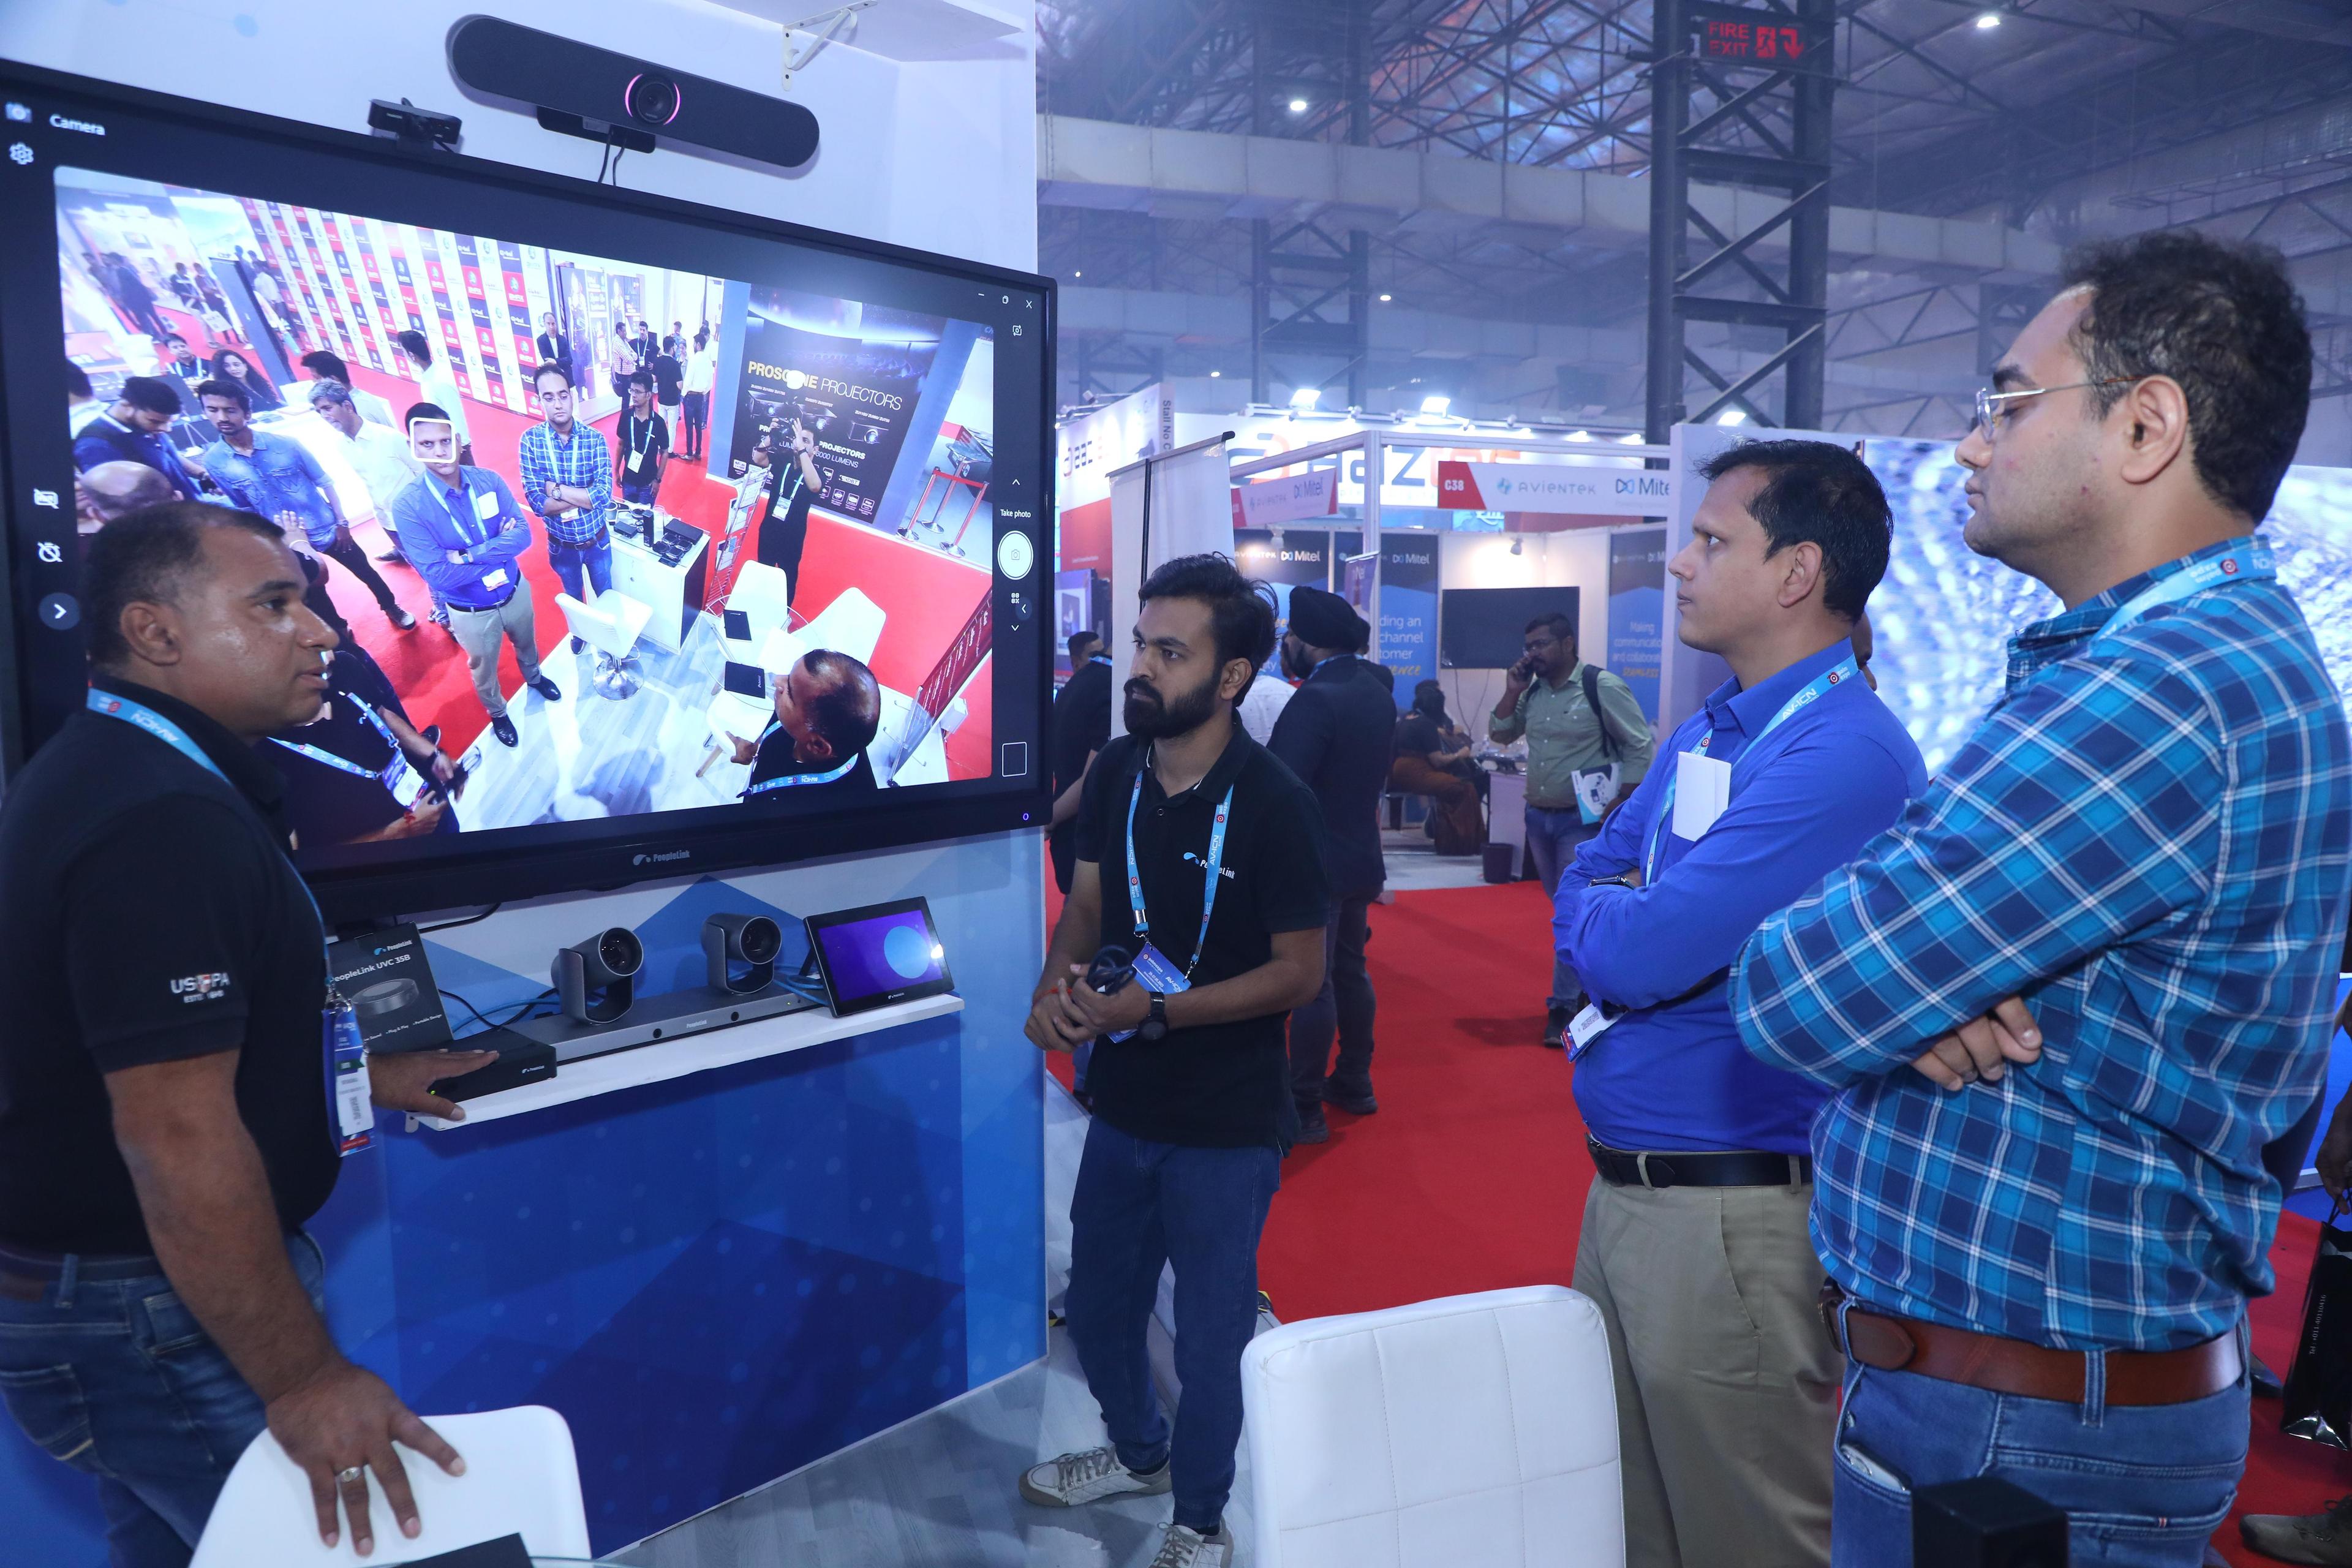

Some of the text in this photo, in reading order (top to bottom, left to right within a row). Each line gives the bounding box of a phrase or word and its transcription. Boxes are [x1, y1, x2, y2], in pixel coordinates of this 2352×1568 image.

[1708, 21, 1750, 39] FIRE
[1709, 39, 1749, 56] EXIT
[49, 113, 106, 136] Camera
[820, 377, 903, 411] PROJECTORS
[1163, 400, 1172, 422] Stall
[1163, 426, 1172, 440] No
[819, 440, 866, 460] PROJECTORS
[831, 452, 859, 469] LUMENS
[1303, 477, 1324, 499] Mitel
[1444, 479, 1464, 492] C38
[1638, 477, 1670, 497] Mite
[1000, 508, 1031, 519] Take photo
[1294, 550, 1321, 563] Mitel
[1405, 553, 1430, 565] Mitel
[1379, 615, 1422, 630] ding an
[1782, 687, 1817, 720] AV-ICN
[653, 850, 690, 862] PeopleLink
[1209, 834, 1219, 866] AV-ICN
[375, 958, 395, 970] UVC
[396, 953, 411, 964] 35B
